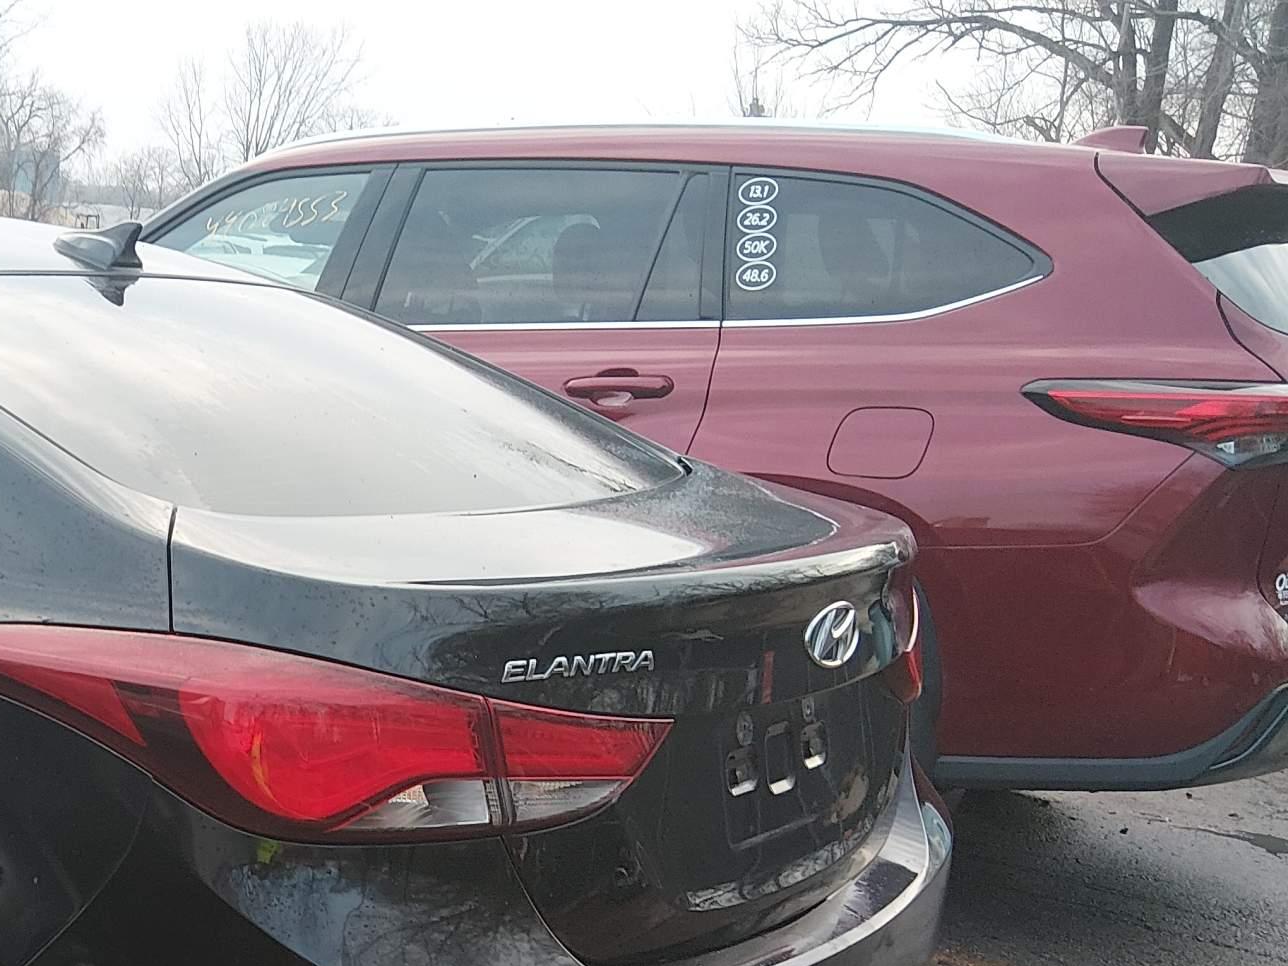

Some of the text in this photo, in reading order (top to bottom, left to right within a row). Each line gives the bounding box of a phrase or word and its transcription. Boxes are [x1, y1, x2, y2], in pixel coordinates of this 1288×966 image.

[749, 185, 769, 198] 13.1
[743, 213, 770, 226] 26.2
[743, 240, 770, 254] 50K
[742, 268, 769, 282] 48.6
[501, 650, 655, 683] ELANTRA
